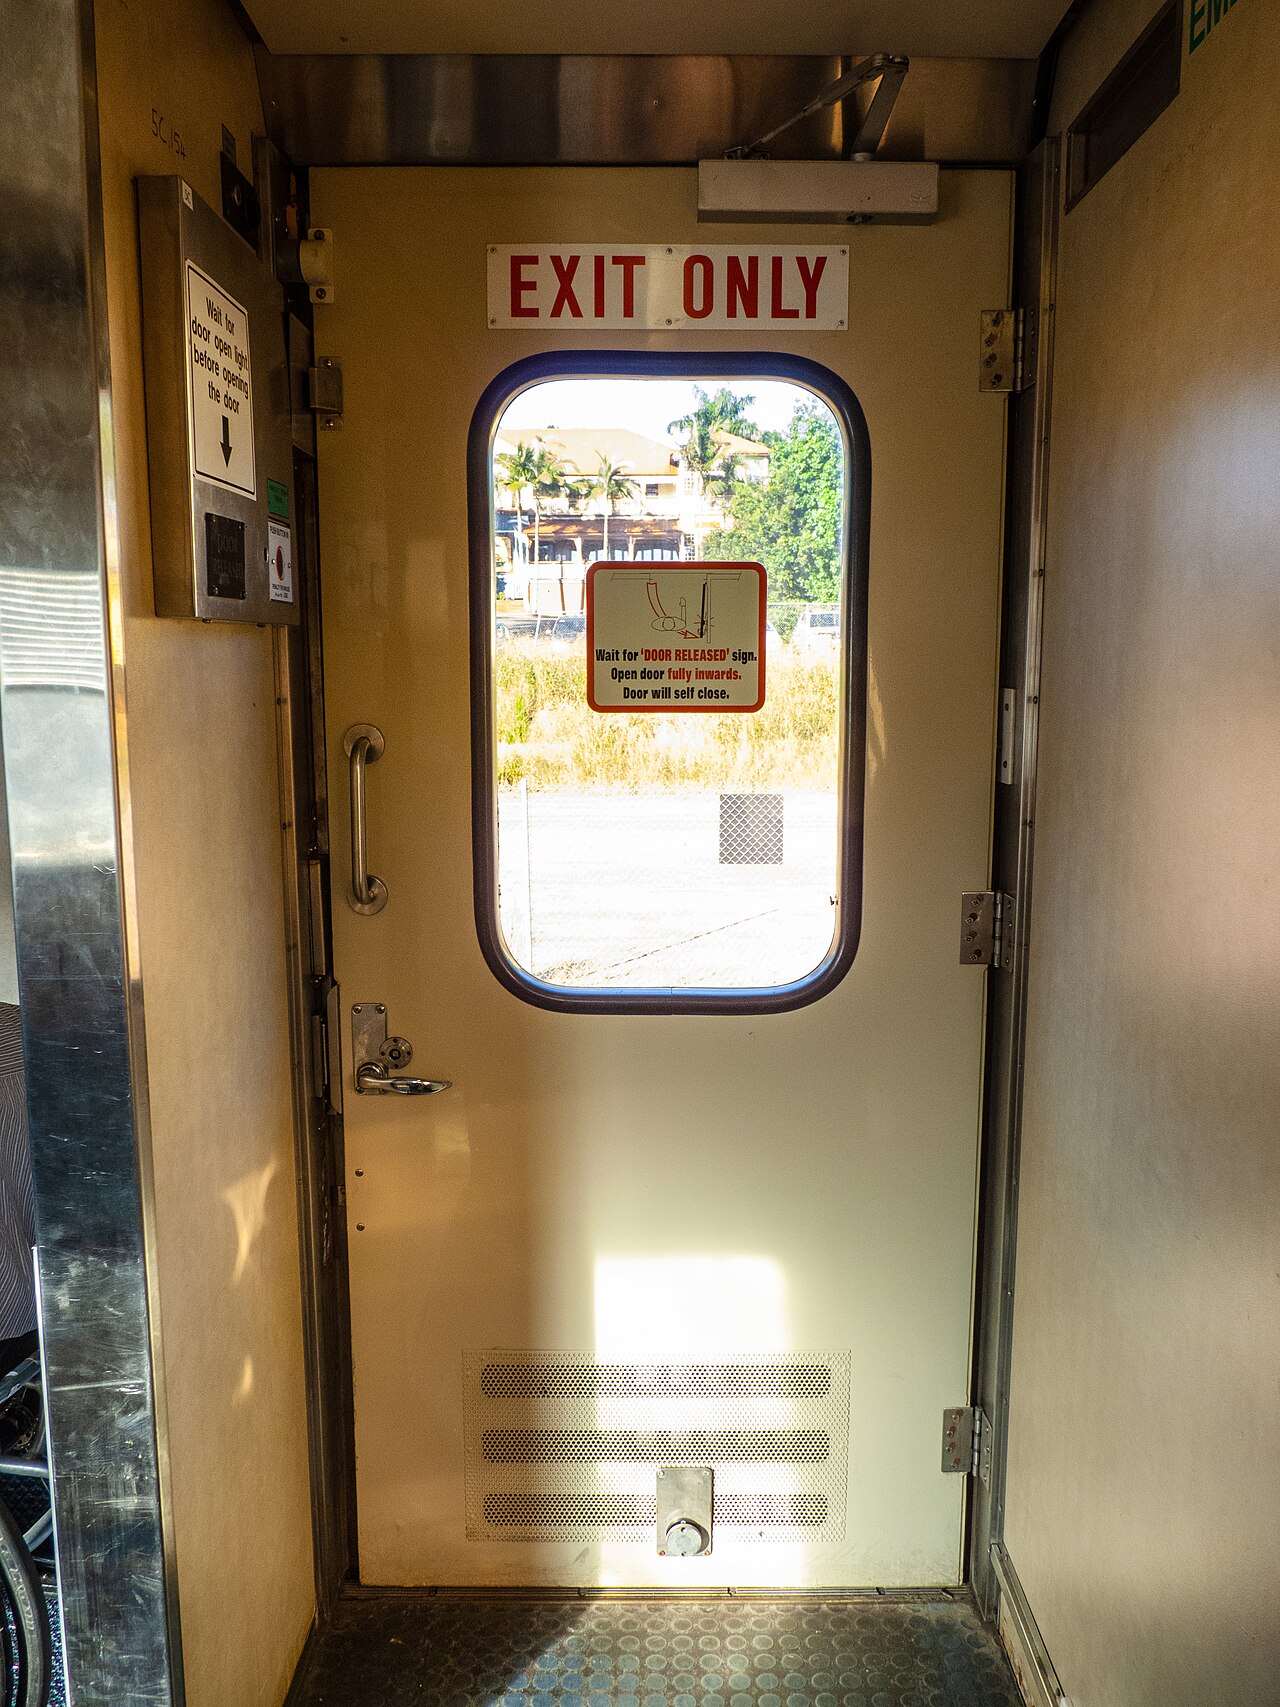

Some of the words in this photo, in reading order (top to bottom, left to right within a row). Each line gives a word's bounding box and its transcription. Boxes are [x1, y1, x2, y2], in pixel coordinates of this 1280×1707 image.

[510, 255, 646, 318] EXIT
[683, 254, 828, 319] ONLY
[206, 297, 223, 326] Wait
[225, 313, 235, 336] for
[191, 316, 211, 344] door
[214, 334, 232, 360] open
[234, 344, 249, 371] light
[193, 343, 220, 376] before
[222, 367, 249, 400] opening
[208, 381, 221, 403] the
[223, 390, 240, 414] door
[595, 649, 620, 662] Wait
[622, 649, 639, 662] for
[732, 649, 758, 665] sign.
[611, 667, 637, 683] Open
[640, 667, 665, 680] door
[667, 667, 692, 683] fully
[695, 667, 742, 680] inwards.
[623, 686, 648, 699] Door
[651, 686, 671, 699] will
[674, 686, 695, 699] self
[697, 686, 729, 699] close.
